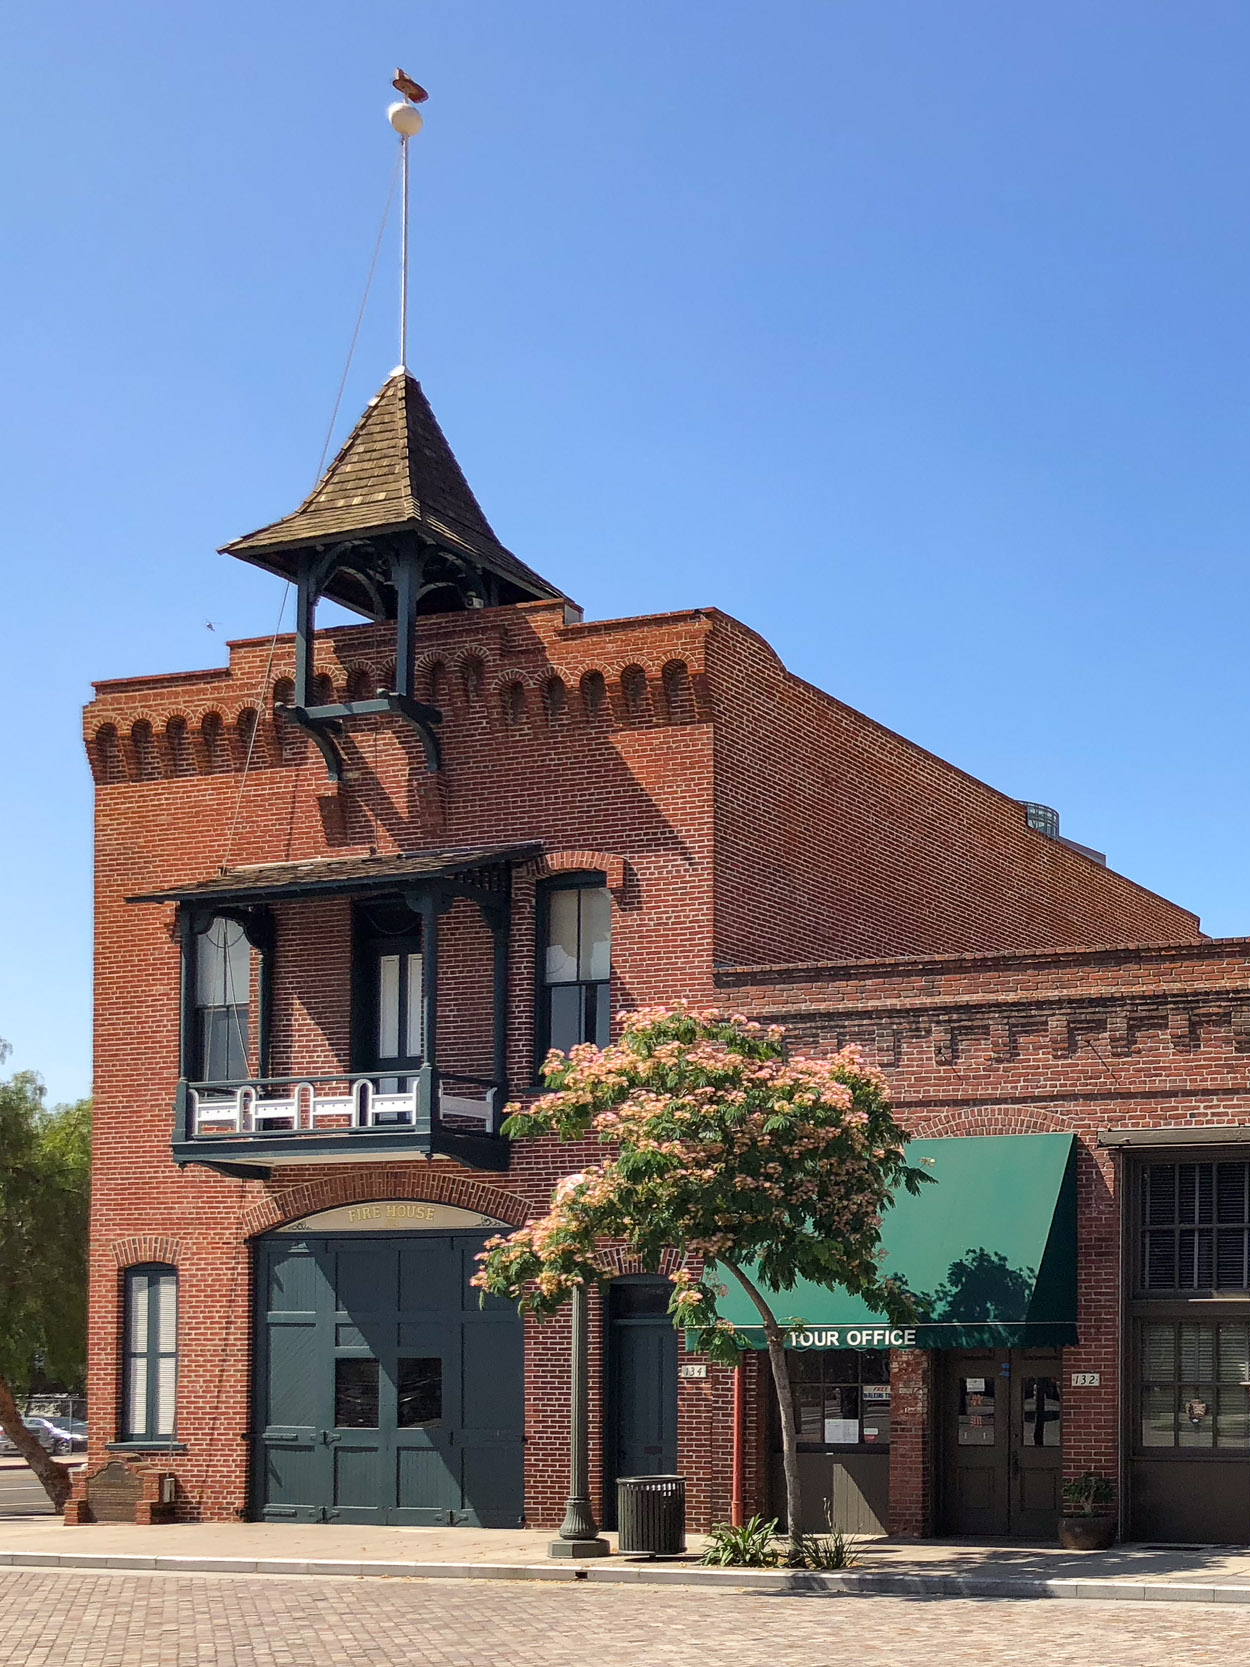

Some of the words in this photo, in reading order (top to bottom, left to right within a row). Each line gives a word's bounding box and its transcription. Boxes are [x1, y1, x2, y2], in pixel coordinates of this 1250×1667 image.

[348, 1206, 381, 1222] FIRE
[386, 1205, 435, 1221] HOUSE
[789, 1331, 840, 1347] TOUR
[846, 1329, 917, 1346] OFFICE
[1075, 1374, 1096, 1385] 132
